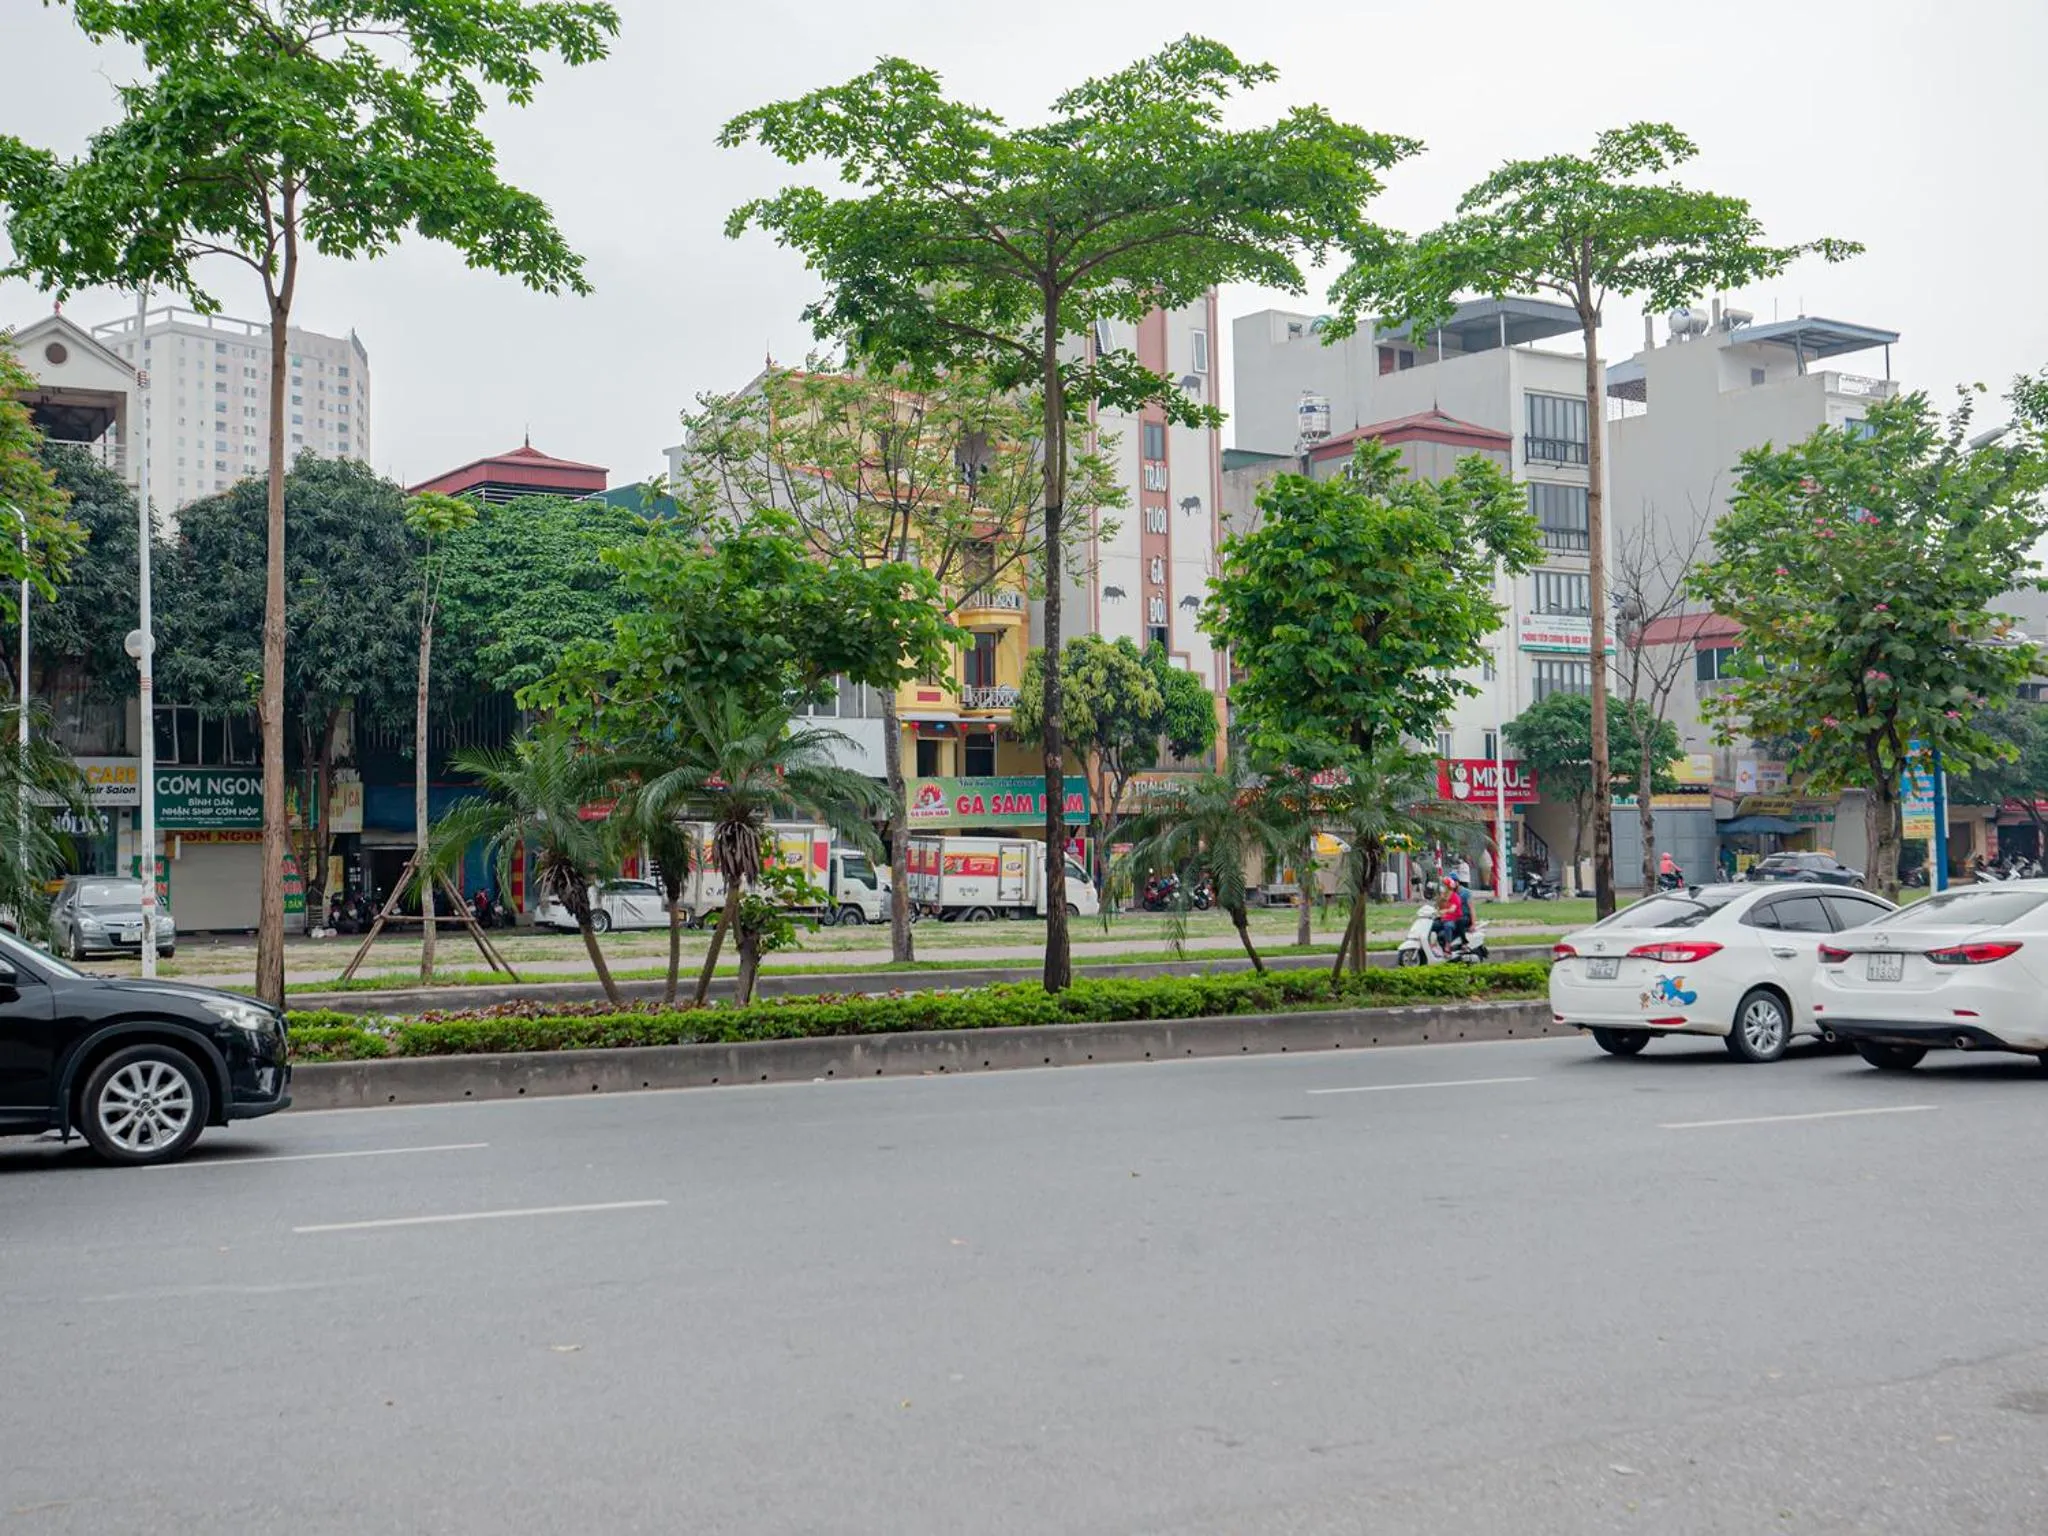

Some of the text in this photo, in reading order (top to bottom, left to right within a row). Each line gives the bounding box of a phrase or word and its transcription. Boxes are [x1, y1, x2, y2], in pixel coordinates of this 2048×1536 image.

[1473, 767, 1531, 788] MIXUE
[106, 784, 136, 795] Salon
[156, 775, 264, 795] CƠM NGON
[188, 797, 211, 806] BÌNH
[191, 808, 213, 816] SHIP
[215, 807, 236, 816] CƠM
